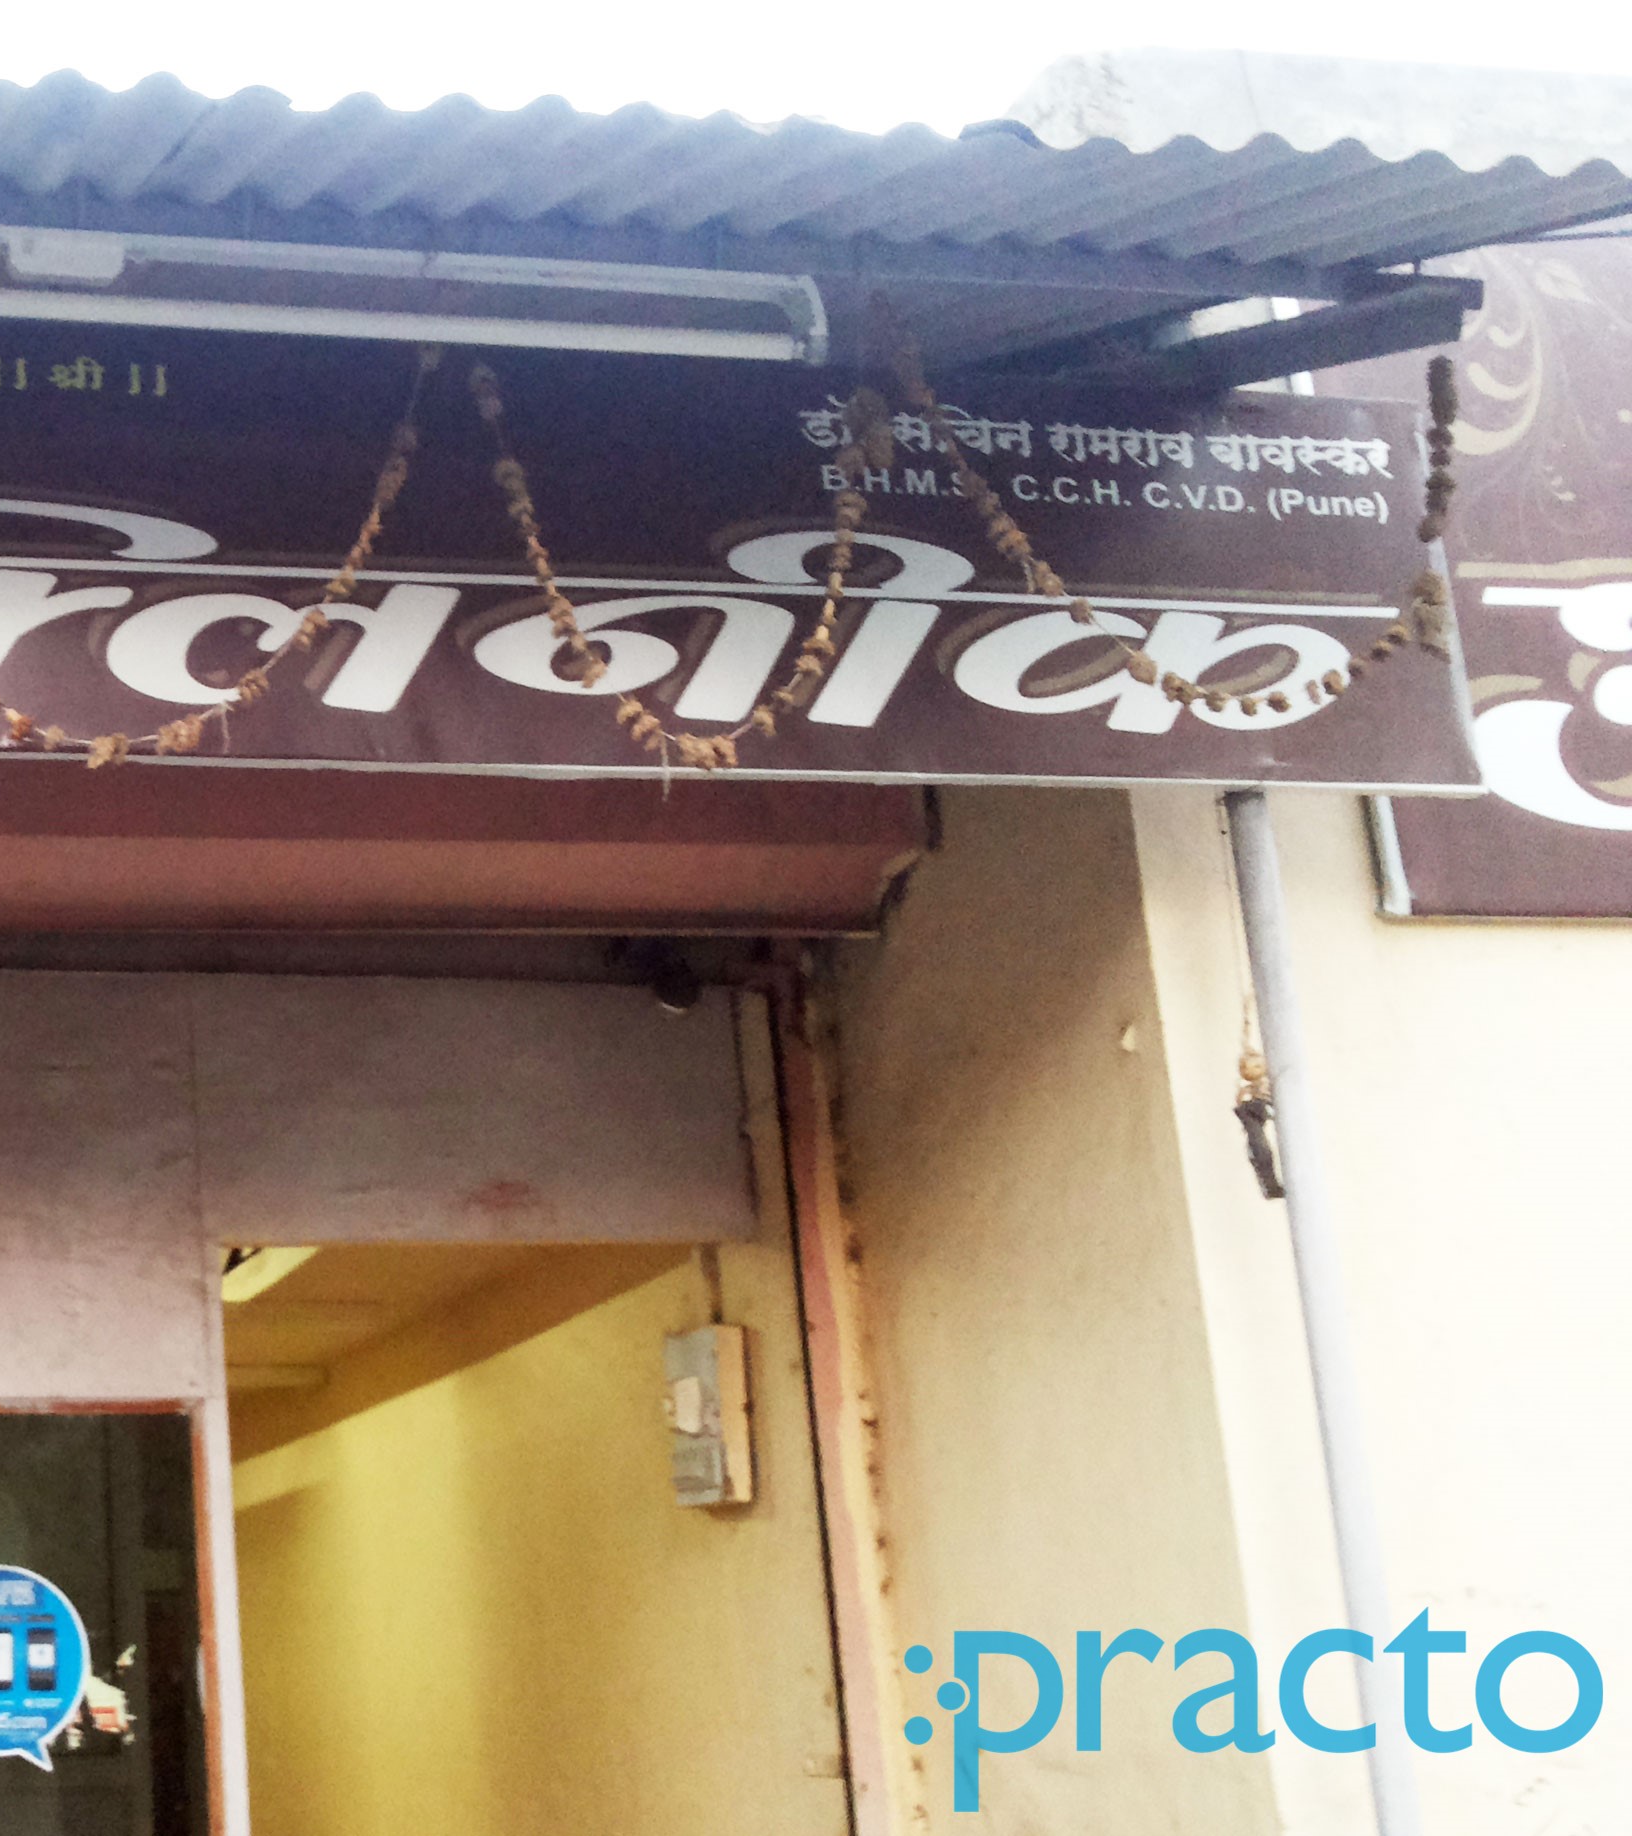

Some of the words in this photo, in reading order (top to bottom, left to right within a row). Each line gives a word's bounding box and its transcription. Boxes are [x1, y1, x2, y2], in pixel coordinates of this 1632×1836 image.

[1048, 422, 1193, 470] रामराव
[1012, 473, 1133, 506] C.C.H.
[1141, 482, 1255, 513] C.V.D.
[1267, 490, 1389, 525] (Pune)
